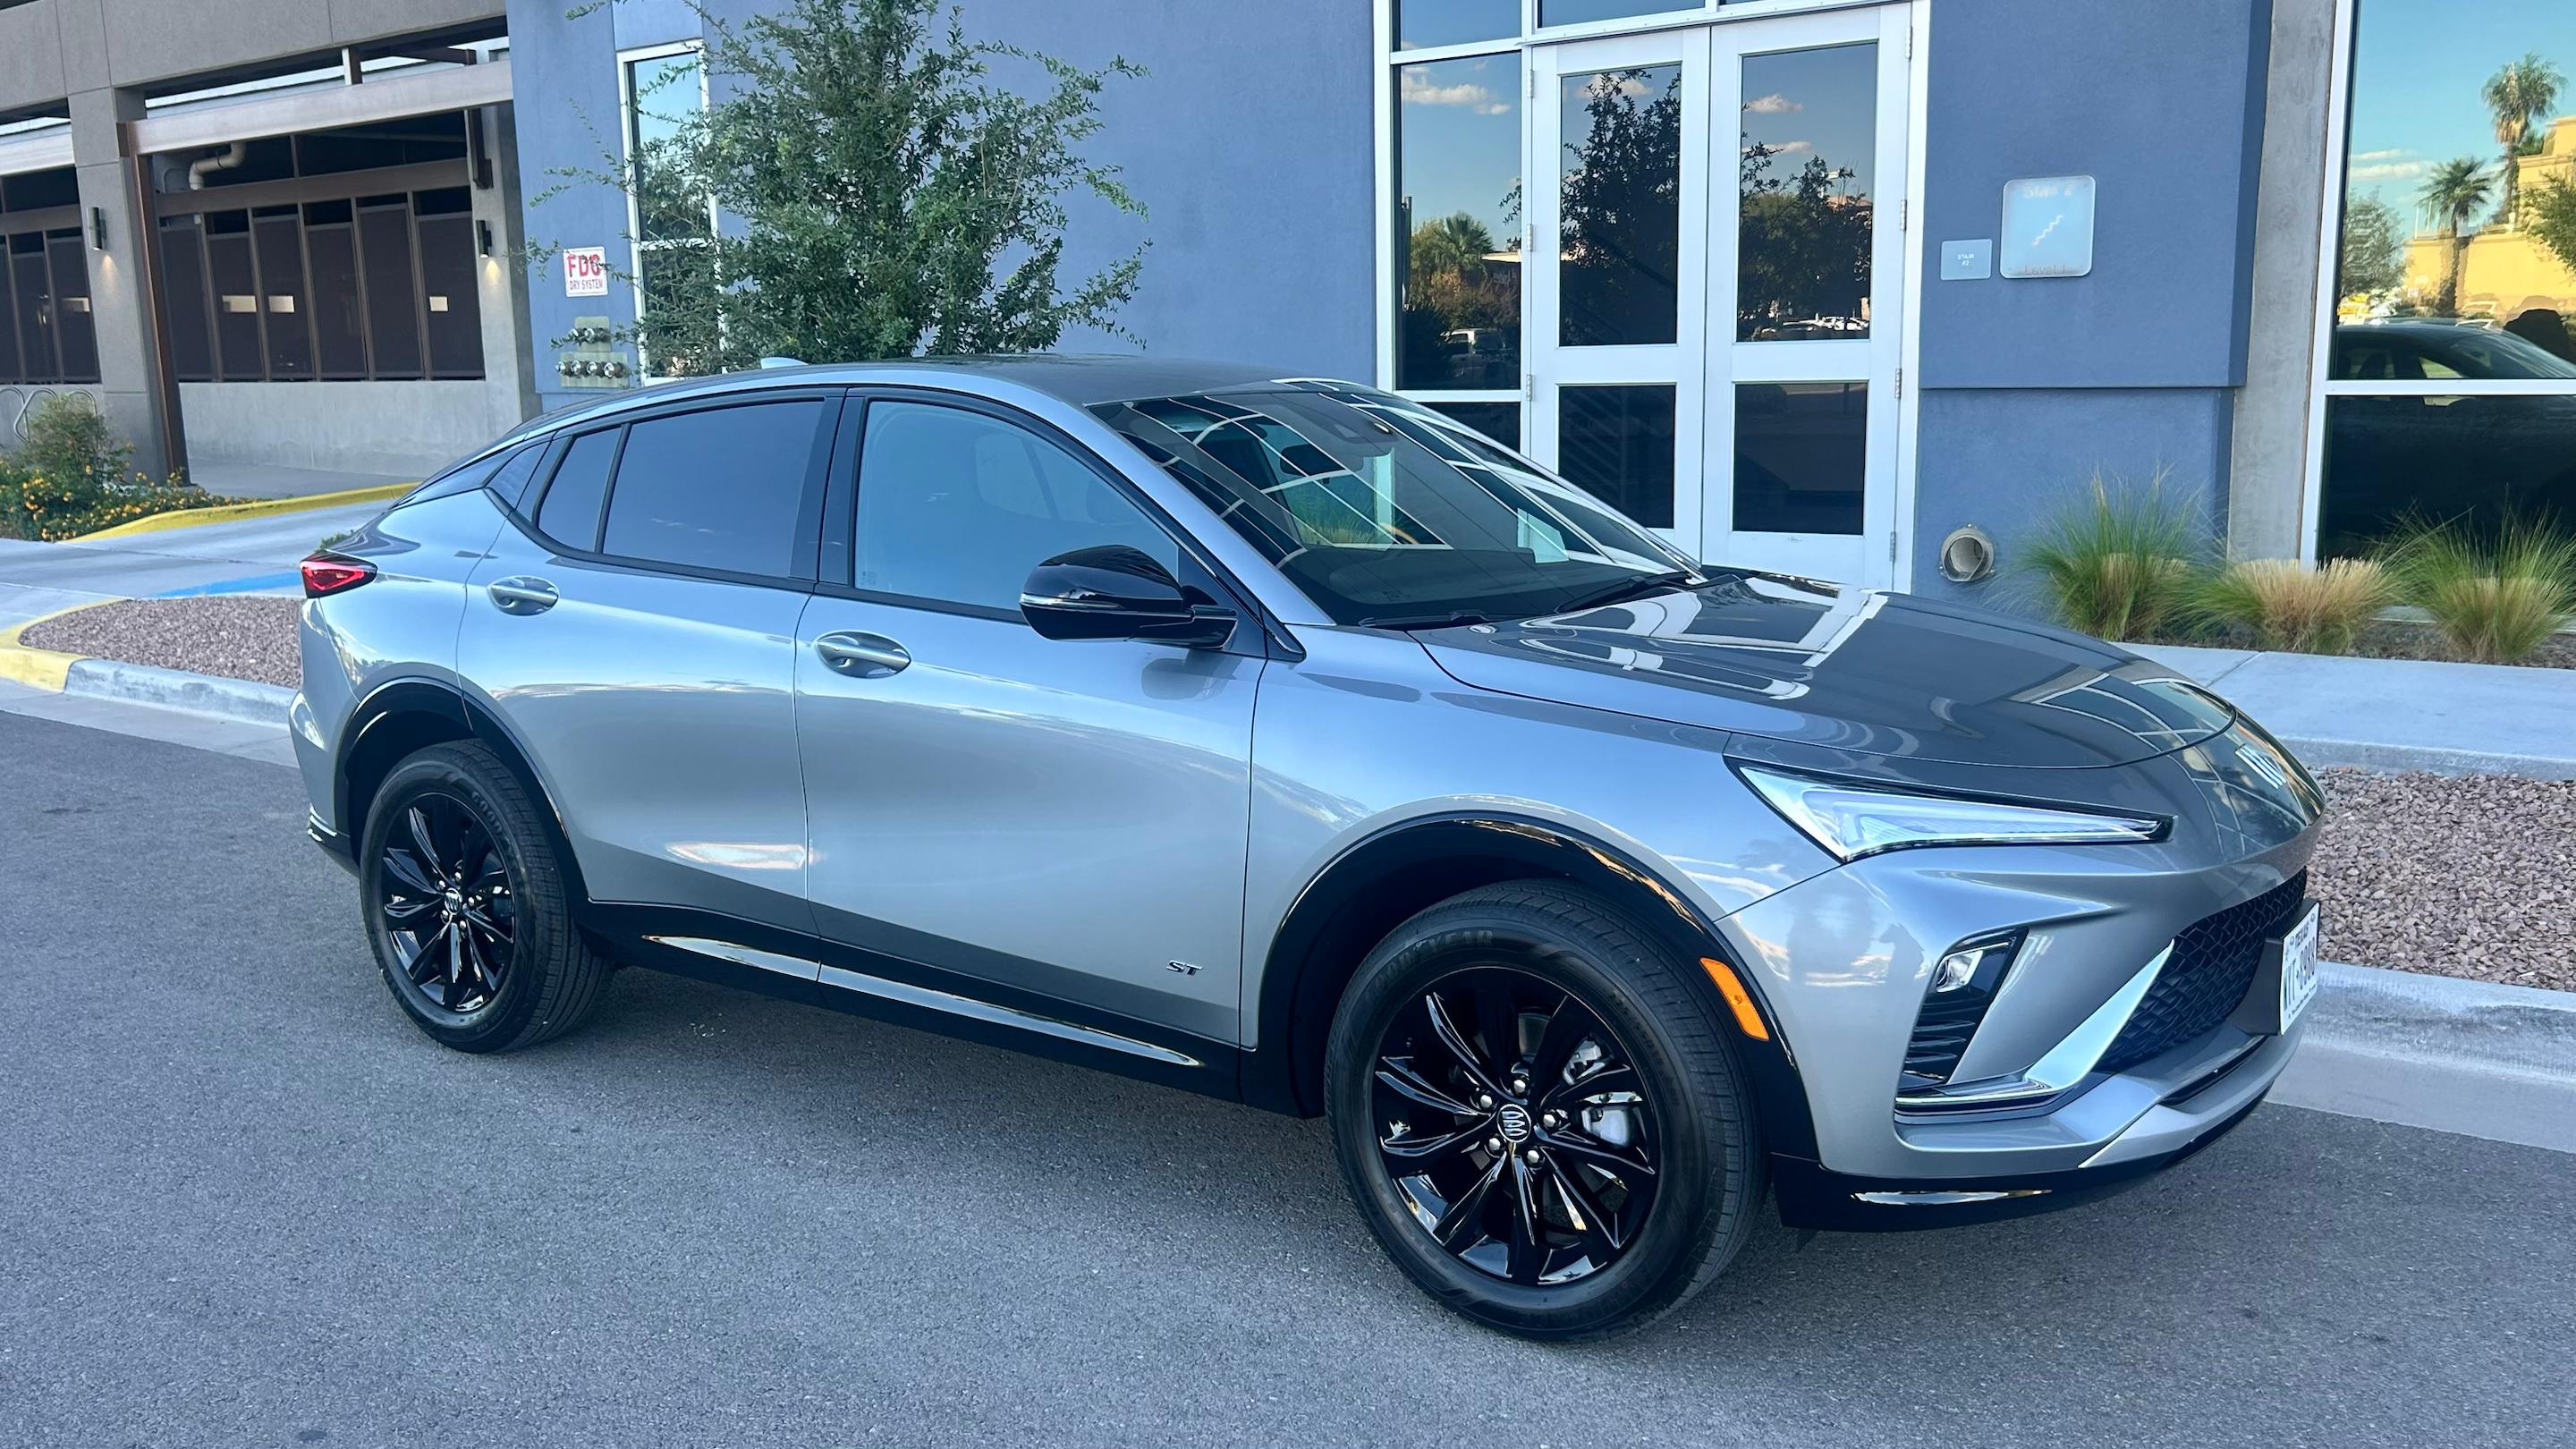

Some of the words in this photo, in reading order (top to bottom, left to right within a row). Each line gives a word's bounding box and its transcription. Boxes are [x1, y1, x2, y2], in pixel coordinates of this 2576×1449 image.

[569, 280, 580, 291] DRY
[581, 279, 603, 290] SYSTEM
[1165, 959, 1203, 977] ST
